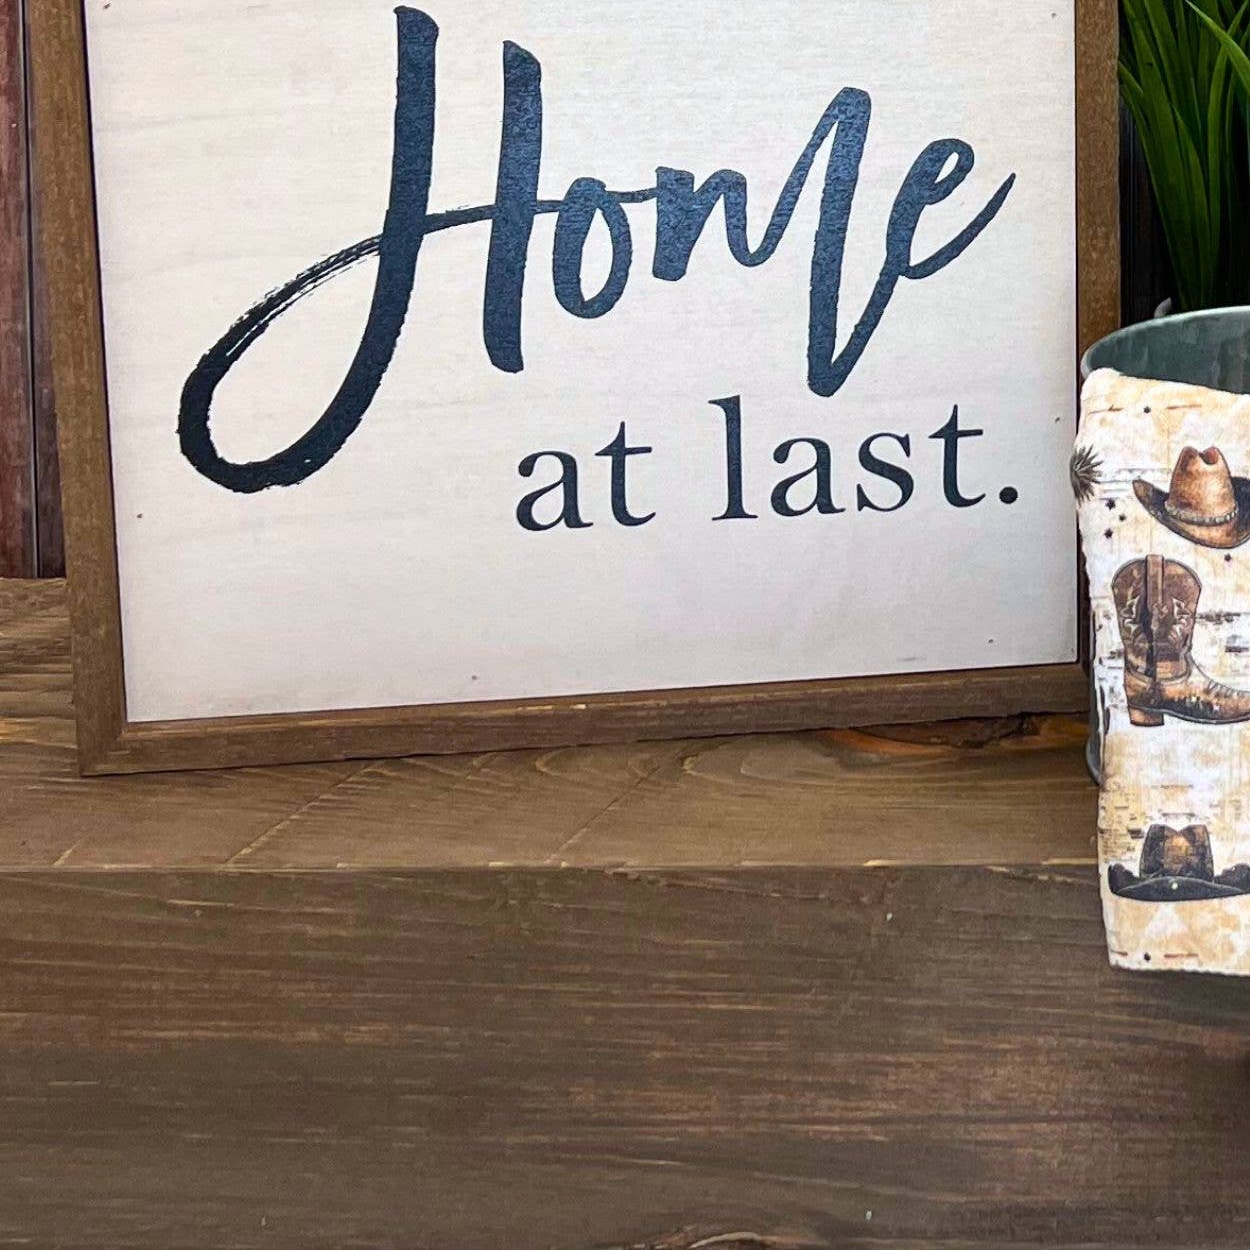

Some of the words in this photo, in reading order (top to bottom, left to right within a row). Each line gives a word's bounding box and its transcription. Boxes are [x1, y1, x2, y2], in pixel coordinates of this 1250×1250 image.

[176, 6, 1016, 494] Home
[516, 422, 656, 531] at
[708, 394, 1019, 522] last.
